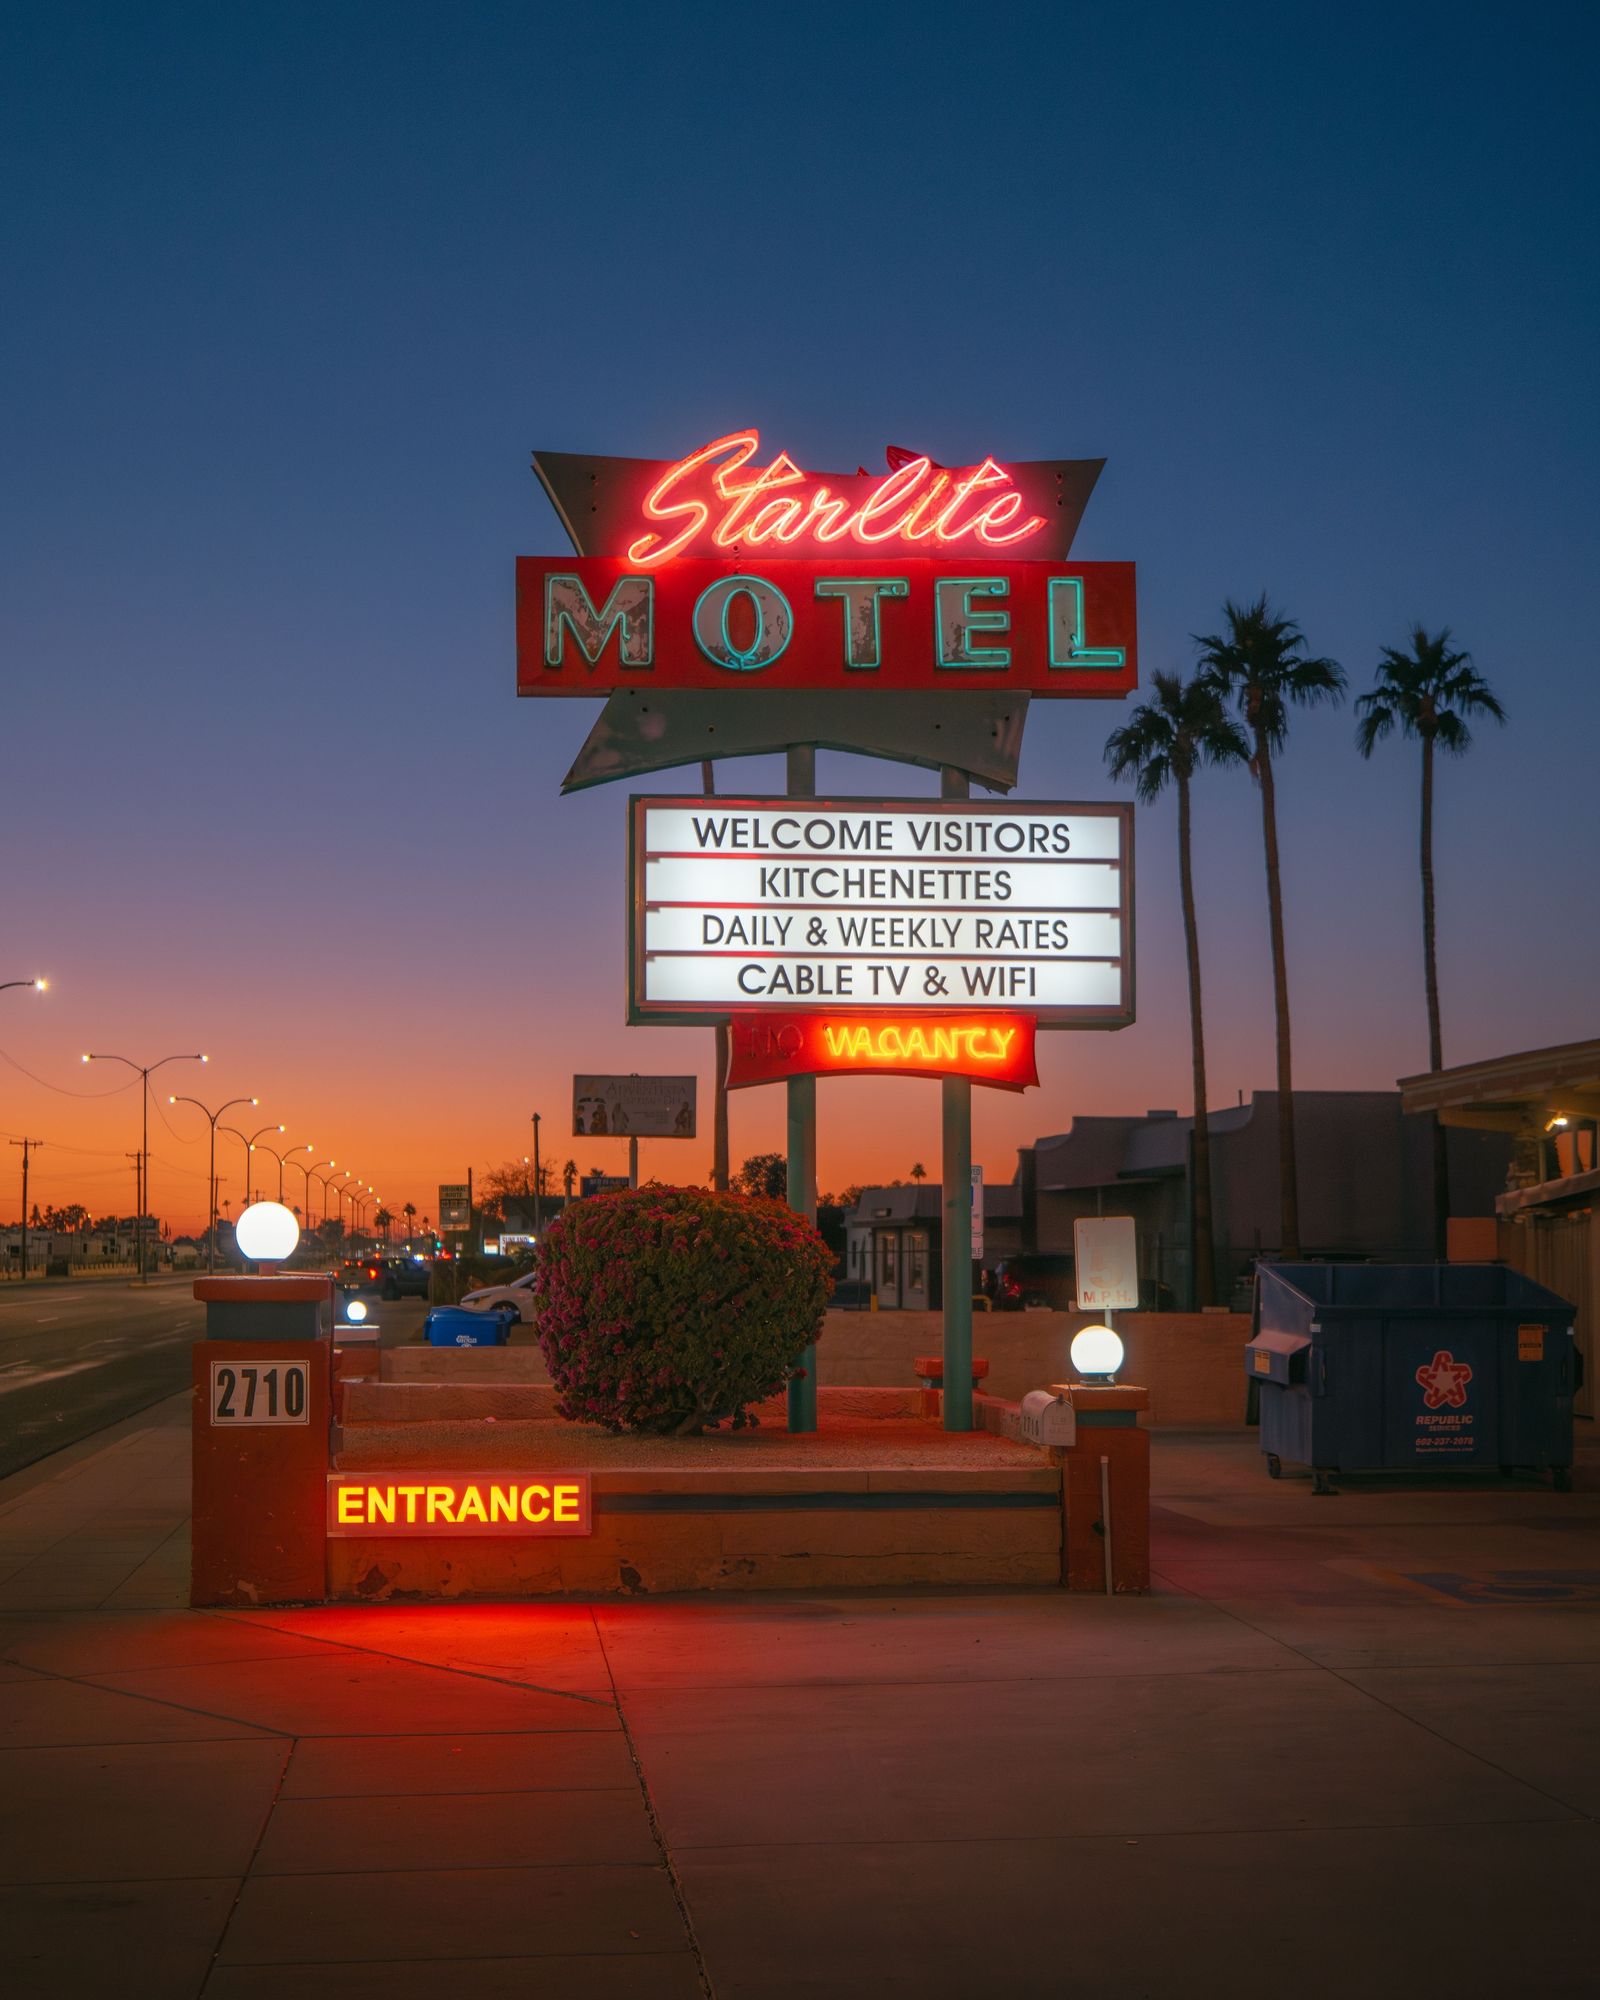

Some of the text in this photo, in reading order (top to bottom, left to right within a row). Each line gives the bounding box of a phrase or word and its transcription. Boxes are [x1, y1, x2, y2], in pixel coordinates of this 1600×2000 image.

[627, 428, 1048, 568] Starlite
[543, 573, 1128, 671] MOTEL
[692, 817, 1071, 854] WELCOME VISITORS
[760, 867, 1012, 901] KITCHENETTES
[703, 914, 1069, 951] DAILY & WEEKLY RATES
[737, 964, 1036, 998] CABLE TV & WIFI
[826, 1026, 1015, 1059] VACANCY
[216, 1367, 305, 1418] 2710
[1416, 1414, 1473, 1424] REPUBLIC
[338, 1485, 580, 1523] ENTRANCE
